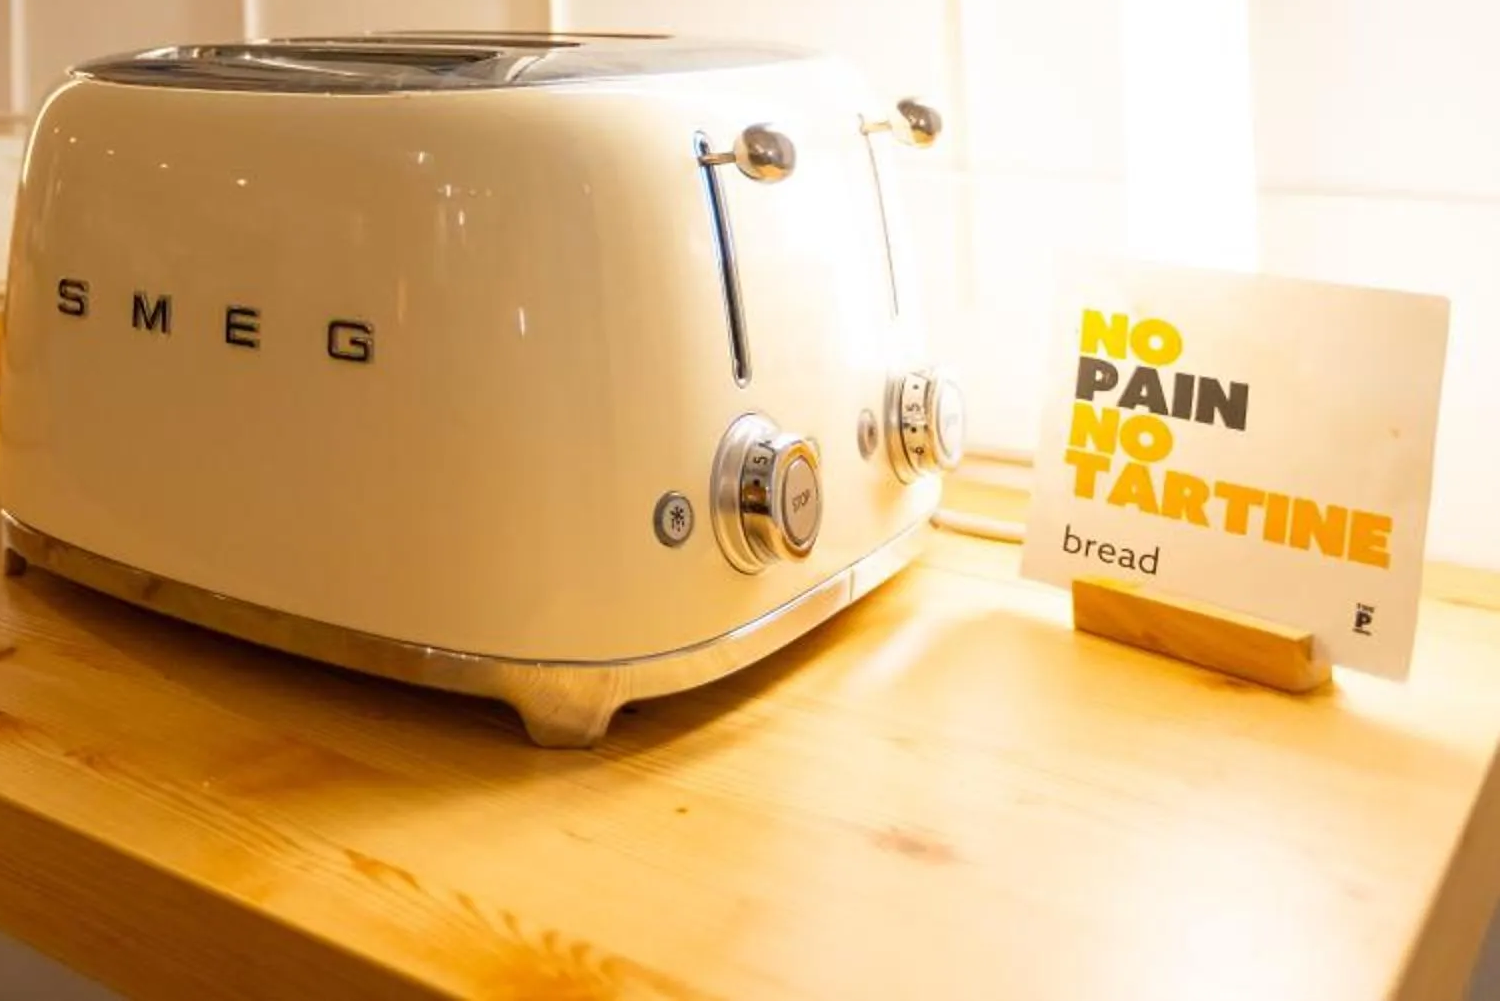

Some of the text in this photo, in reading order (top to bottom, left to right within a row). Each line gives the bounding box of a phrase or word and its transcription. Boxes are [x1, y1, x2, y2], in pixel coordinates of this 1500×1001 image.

[57, 278, 374, 364] SMEG
[1079, 309, 1183, 366] NO
[1075, 356, 1249, 431] PAIN
[1068, 402, 1173, 463] NO
[1065, 450, 1393, 569] TARTINE
[1062, 524, 1160, 576] bread
